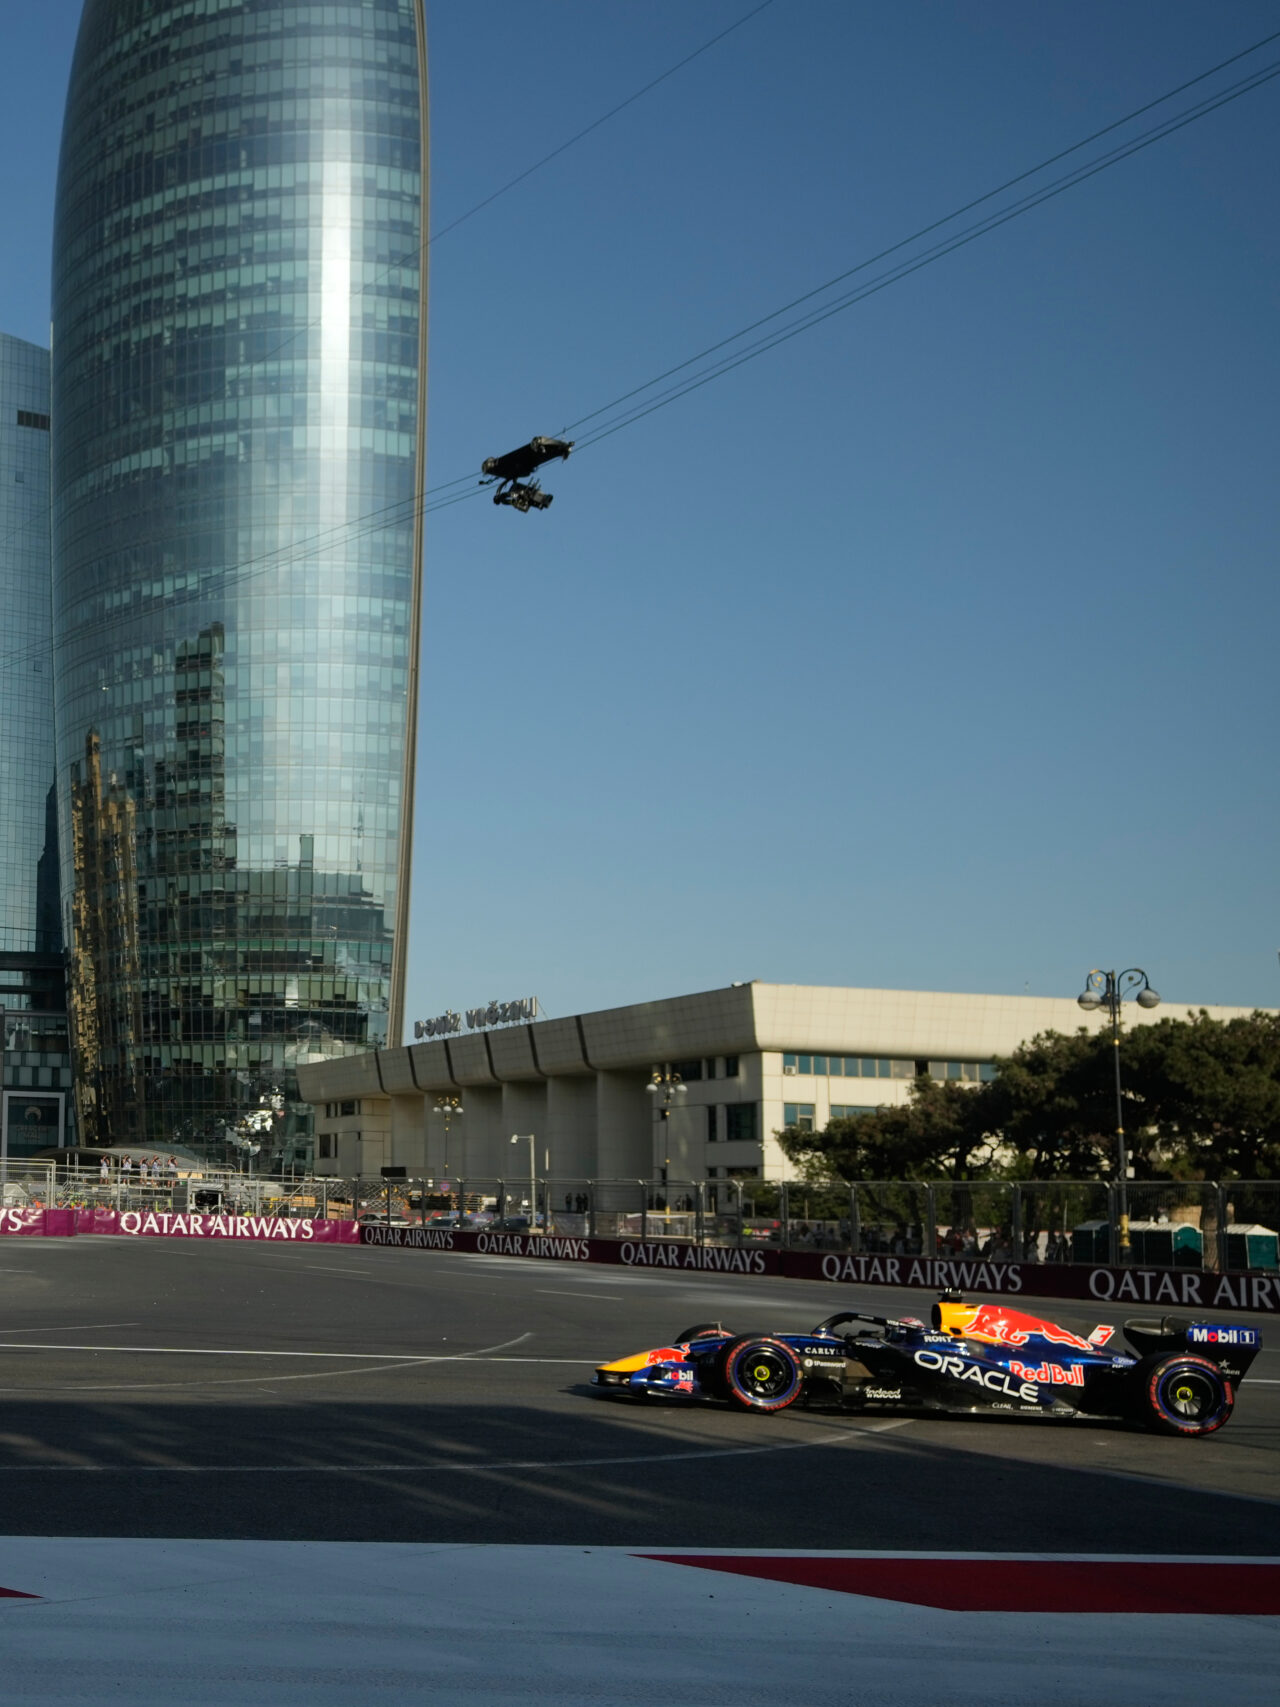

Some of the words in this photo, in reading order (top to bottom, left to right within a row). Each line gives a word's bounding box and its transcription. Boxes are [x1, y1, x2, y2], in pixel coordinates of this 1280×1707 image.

[120, 1211, 204, 1236] QATAR
[210, 1215, 314, 1240] AIRWAYS
[365, 1227, 402, 1247] QATAR
[404, 1229, 454, 1249] AIRWAYS
[477, 1233, 522, 1255] QATAR
[525, 1237, 589, 1260] AIRWAYS
[621, 1242, 679, 1267] QATAR
[683, 1246, 766, 1274] AIRWAYS
[822, 1254, 901, 1283] QATAR
[907, 1259, 1022, 1293] AIRWAYS
[1089, 1268, 1202, 1304] QATAR
[1193, 1328, 1237, 1344] Mobil
[913, 1350, 1040, 1403] ORACLE
[1008, 1360, 1048, 1383] Red
[1050, 1362, 1085, 1388] Bull
